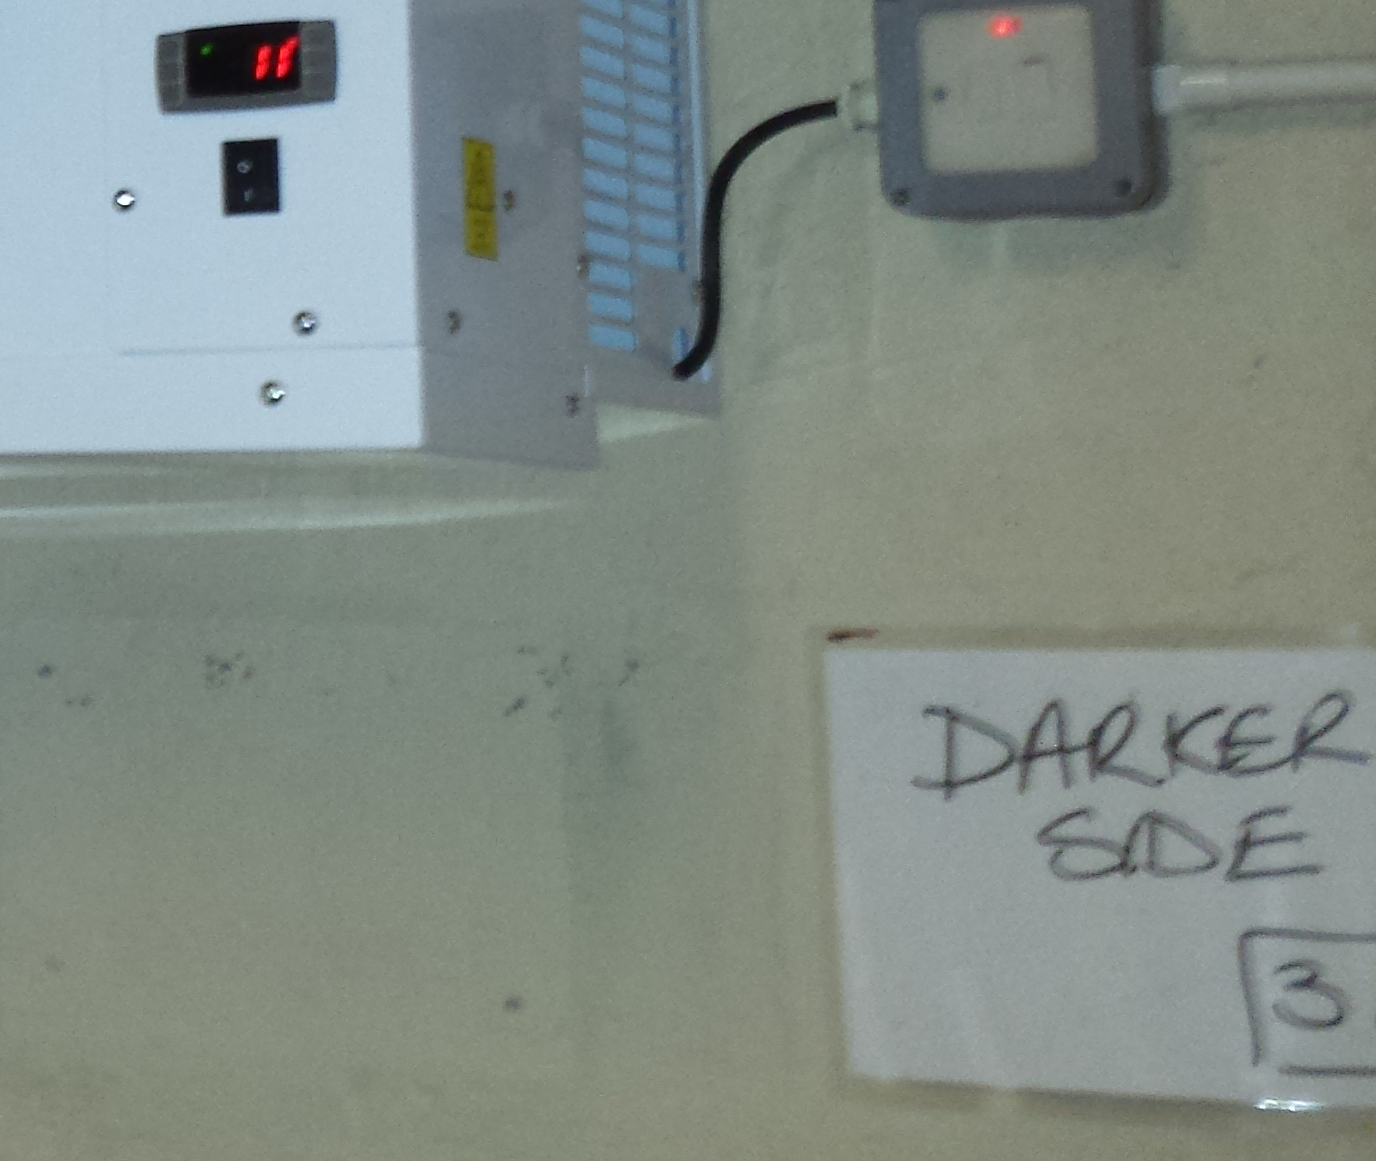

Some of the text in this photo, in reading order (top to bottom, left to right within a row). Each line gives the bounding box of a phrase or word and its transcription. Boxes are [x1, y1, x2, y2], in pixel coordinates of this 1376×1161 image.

[911, 690, 1371, 801] DARKER
[1036, 806, 1325, 881] SIDE
[1271, 958, 1347, 1030] 3
